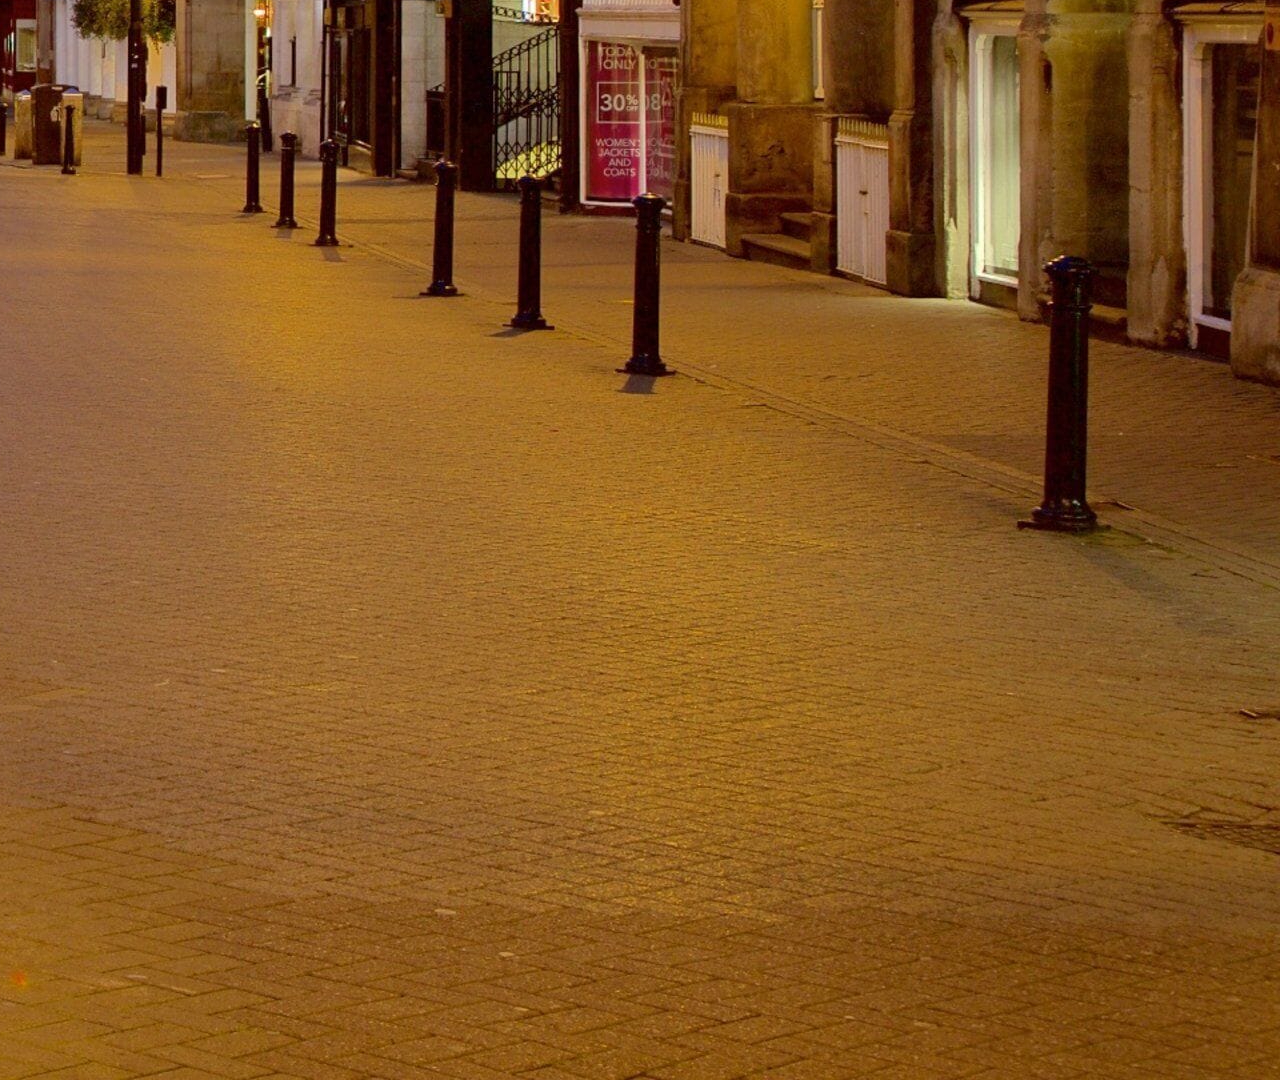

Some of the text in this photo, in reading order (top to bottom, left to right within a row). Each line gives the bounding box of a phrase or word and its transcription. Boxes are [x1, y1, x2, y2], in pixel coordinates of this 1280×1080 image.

[603, 59, 637, 69] ONLY
[598, 148, 640, 157] JACKETS
[608, 158, 632, 166] AND
[603, 167, 636, 177] COATS
